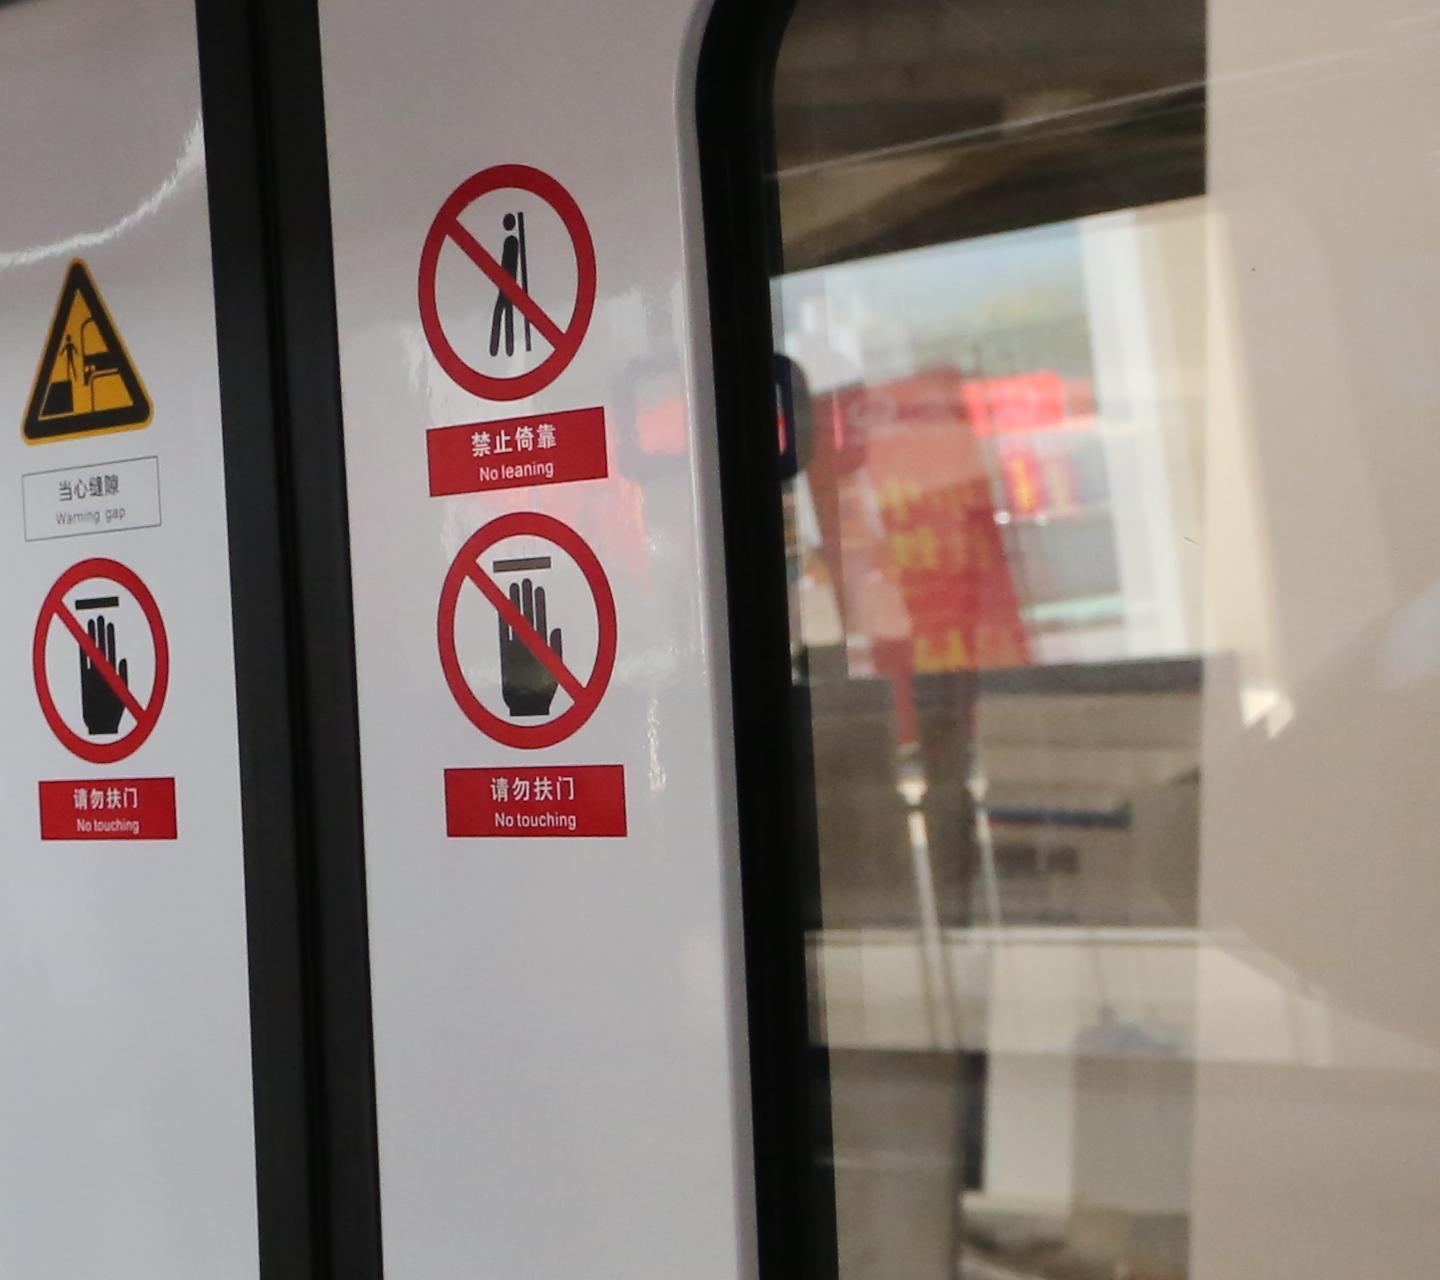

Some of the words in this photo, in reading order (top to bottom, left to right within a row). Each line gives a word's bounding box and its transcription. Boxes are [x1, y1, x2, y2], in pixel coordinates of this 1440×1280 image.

[470, 423, 557, 457] 禁止倚靠
[479, 464, 498, 483] No
[501, 457, 555, 481] leaning
[59, 474, 120, 502] 当心缝隙
[105, 507, 126, 524] gap
[73, 787, 138, 810] 请勿扶门
[490, 775, 576, 803] 请勿扶门
[76, 818, 92, 833] No
[94, 818, 140, 835] touching
[494, 812, 512, 829] No
[516, 809, 578, 832] touching
